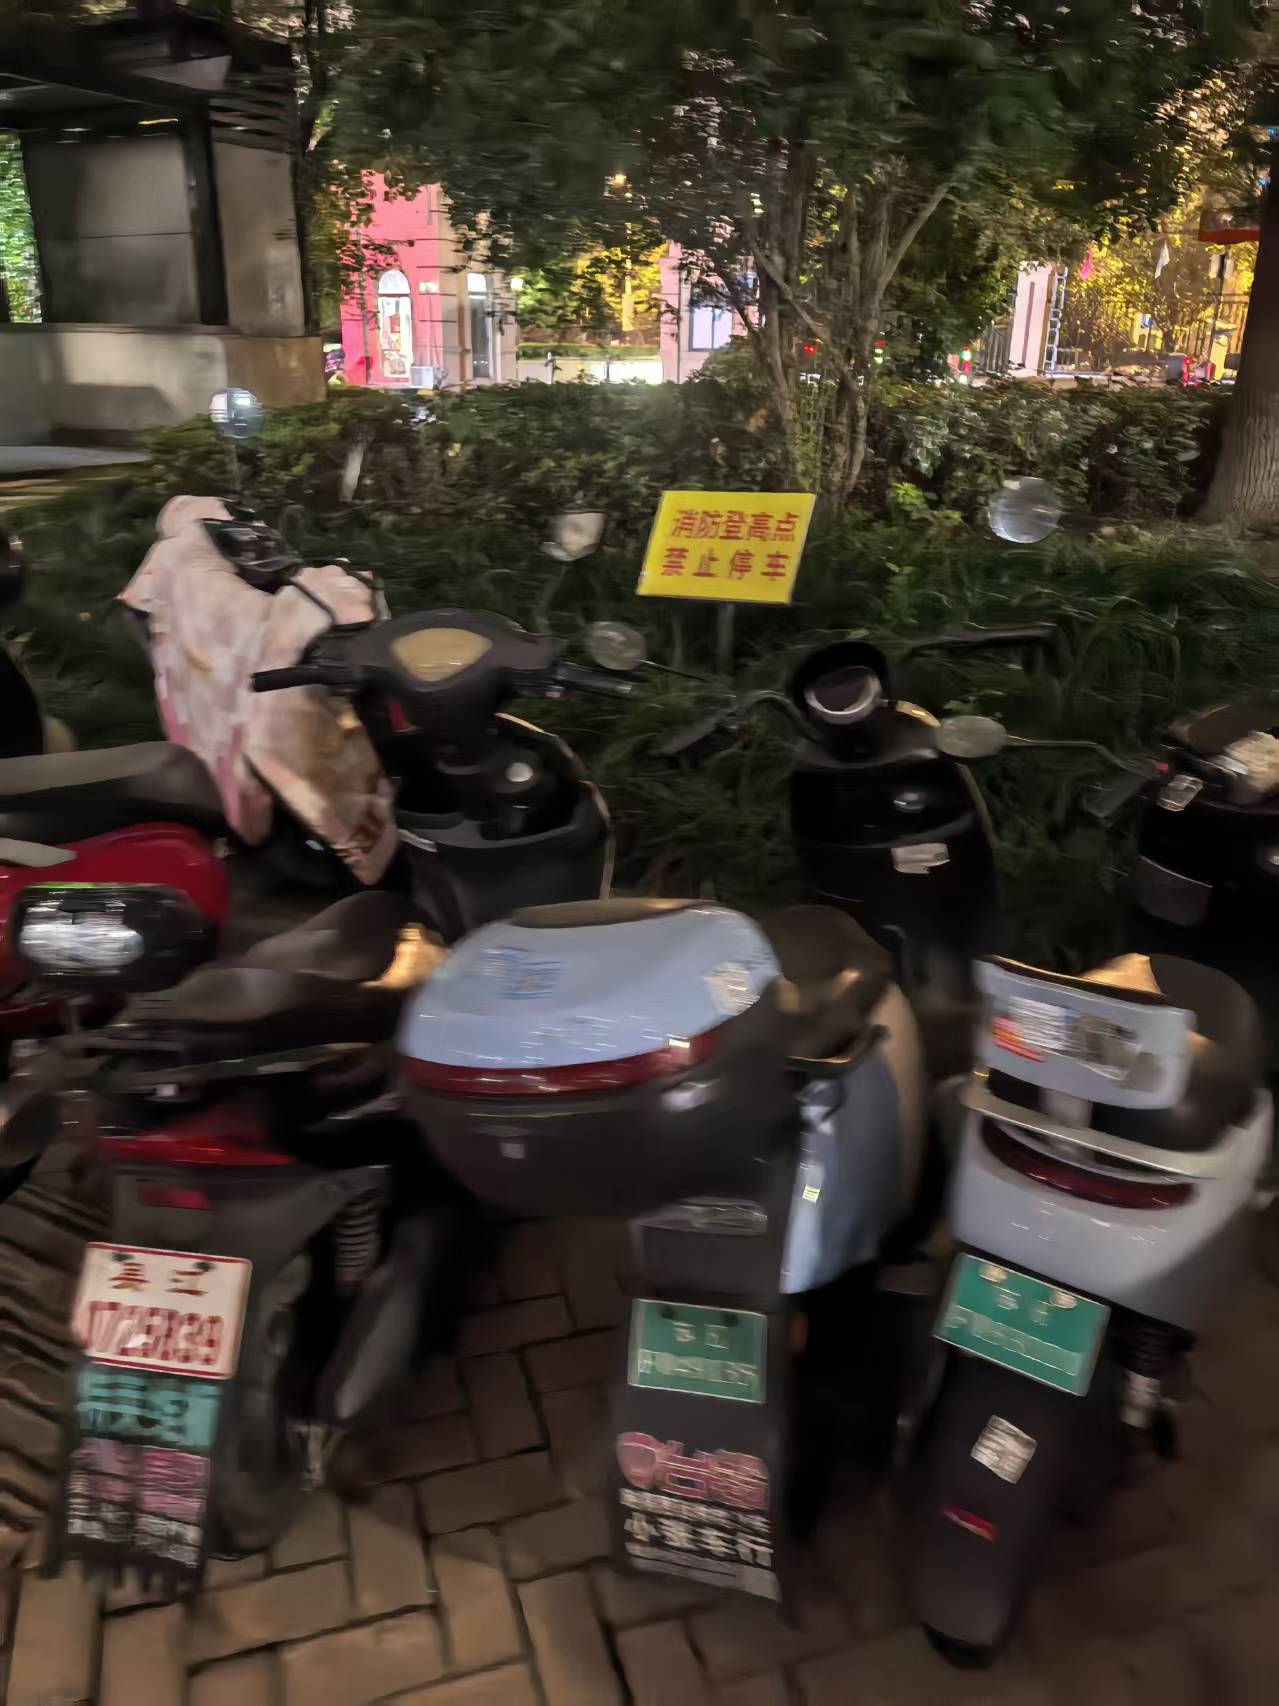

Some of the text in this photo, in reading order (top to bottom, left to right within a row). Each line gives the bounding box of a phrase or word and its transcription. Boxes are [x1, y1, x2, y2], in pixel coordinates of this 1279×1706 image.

[672, 509, 798, 541] 消防登高点
[661, 547, 789, 580] 禁止停车
